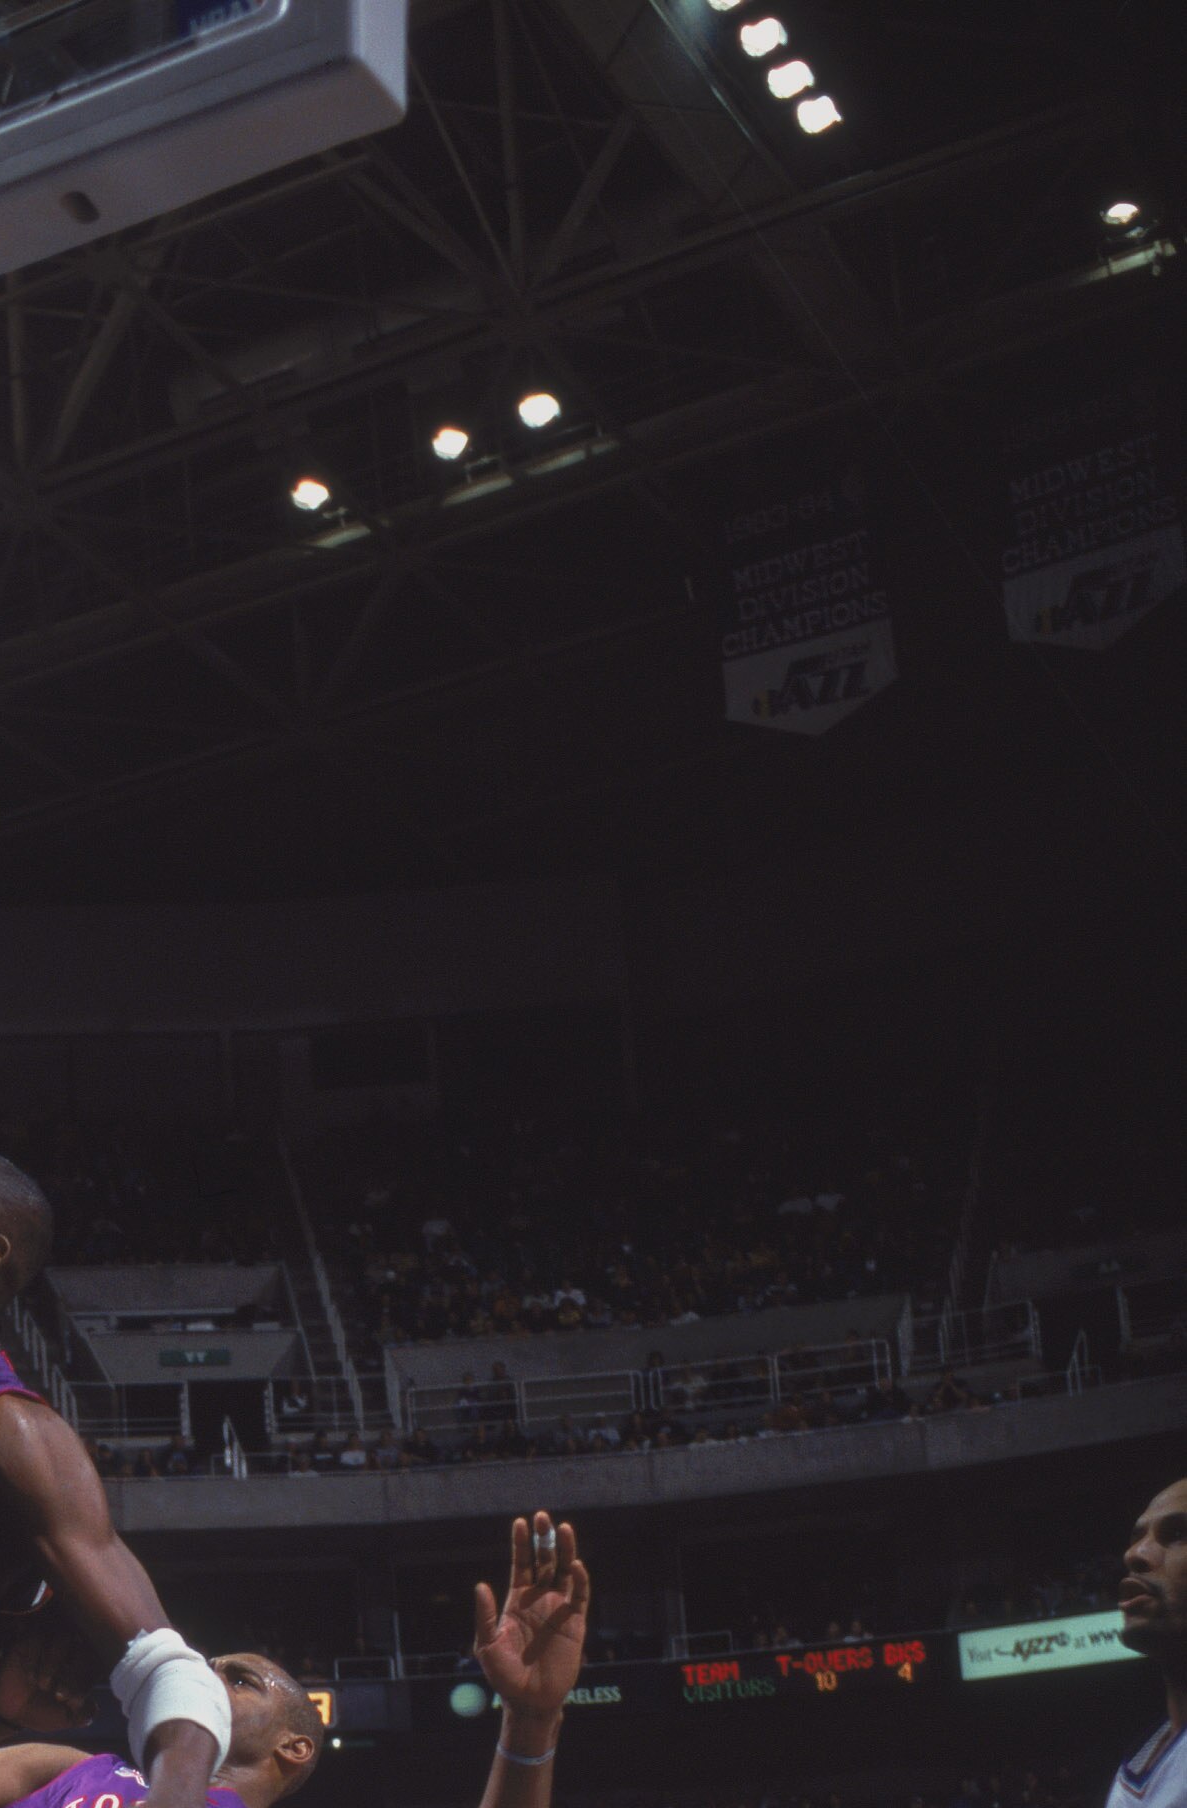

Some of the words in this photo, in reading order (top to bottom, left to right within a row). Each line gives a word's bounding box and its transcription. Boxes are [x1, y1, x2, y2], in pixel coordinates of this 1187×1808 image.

[680, 1660, 741, 1687] TEAM
[682, 1675, 777, 1704] VISITORS
[815, 1670, 838, 1692] 10
[896, 1661, 914, 1683] 4
